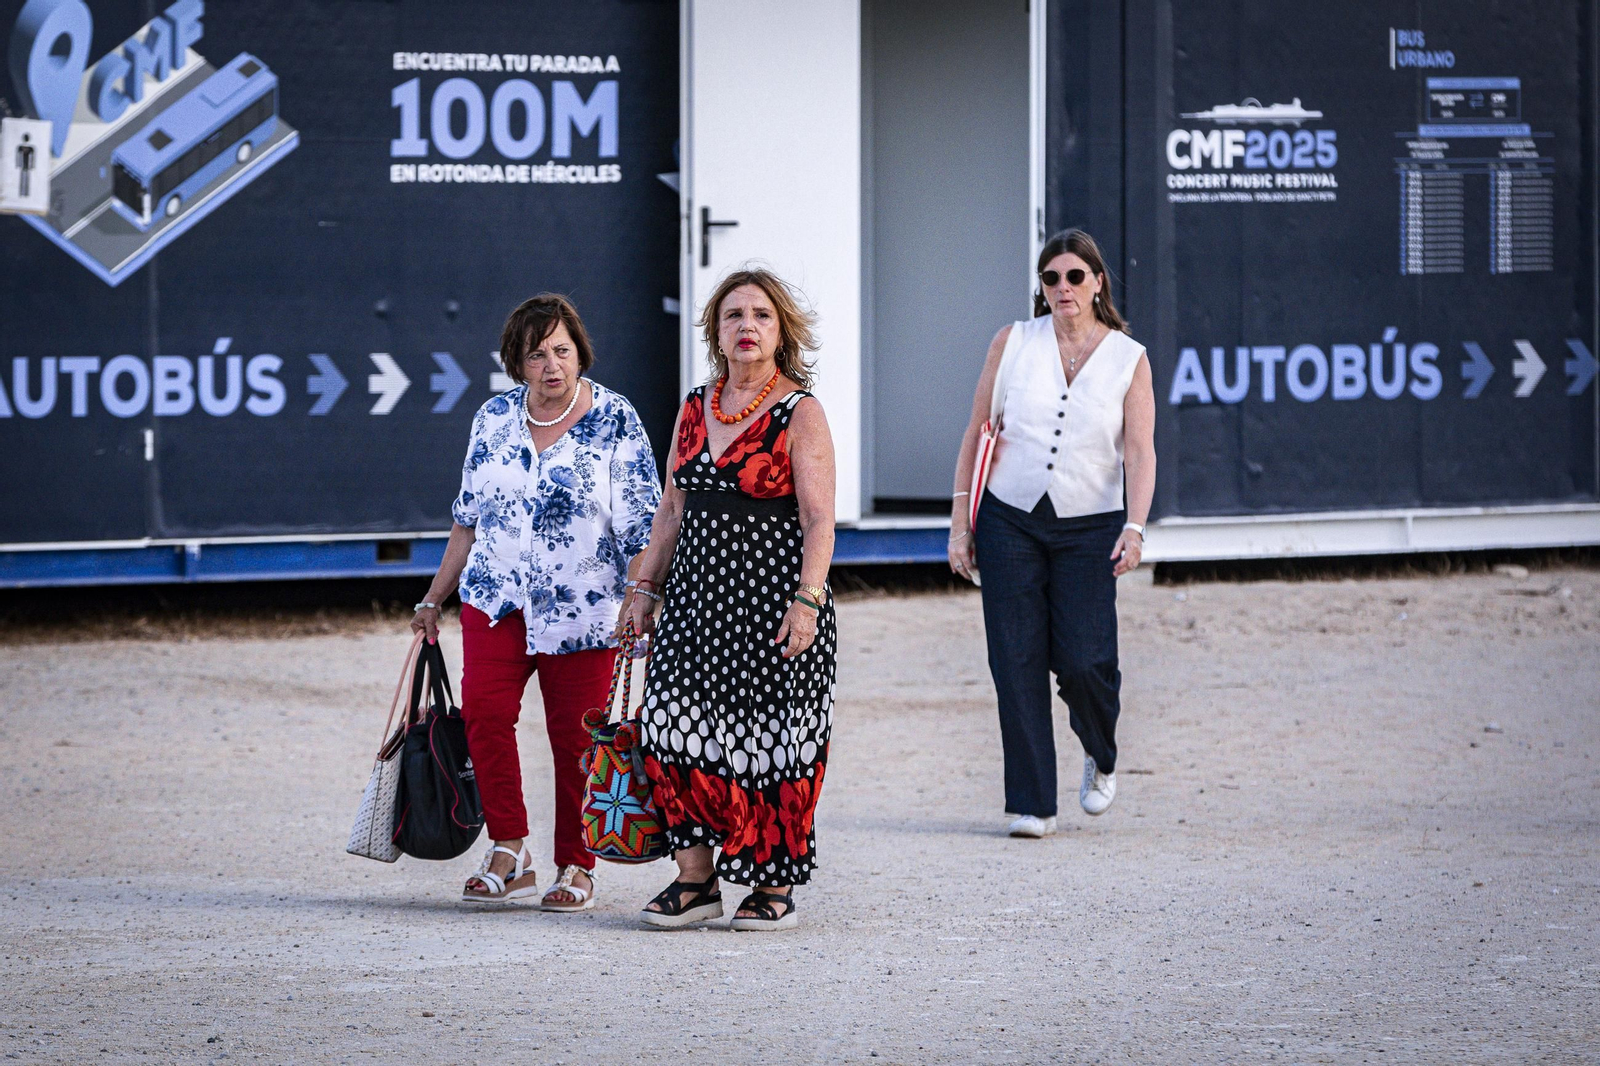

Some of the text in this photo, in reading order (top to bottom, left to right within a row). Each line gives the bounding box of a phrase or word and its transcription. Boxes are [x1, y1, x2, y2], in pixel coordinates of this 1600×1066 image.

[1397, 29, 1426, 48] BUS
[88, 0, 205, 123] CMF
[393, 52, 621, 73] ENCUENTRA TU PARADA A
[1397, 49, 1455, 68] URBANO
[390, 77, 619, 160] 100M
[1166, 129, 1338, 170] CMF2025
[390, 161, 622, 184] EN ROTONDA DE HÉRCULES
[1166, 173, 1338, 188] CONCERT MUSIC FESTIVAL
[1170, 326, 1442, 405] AUTOBÚS
[458, 770, 474, 778] Santa
